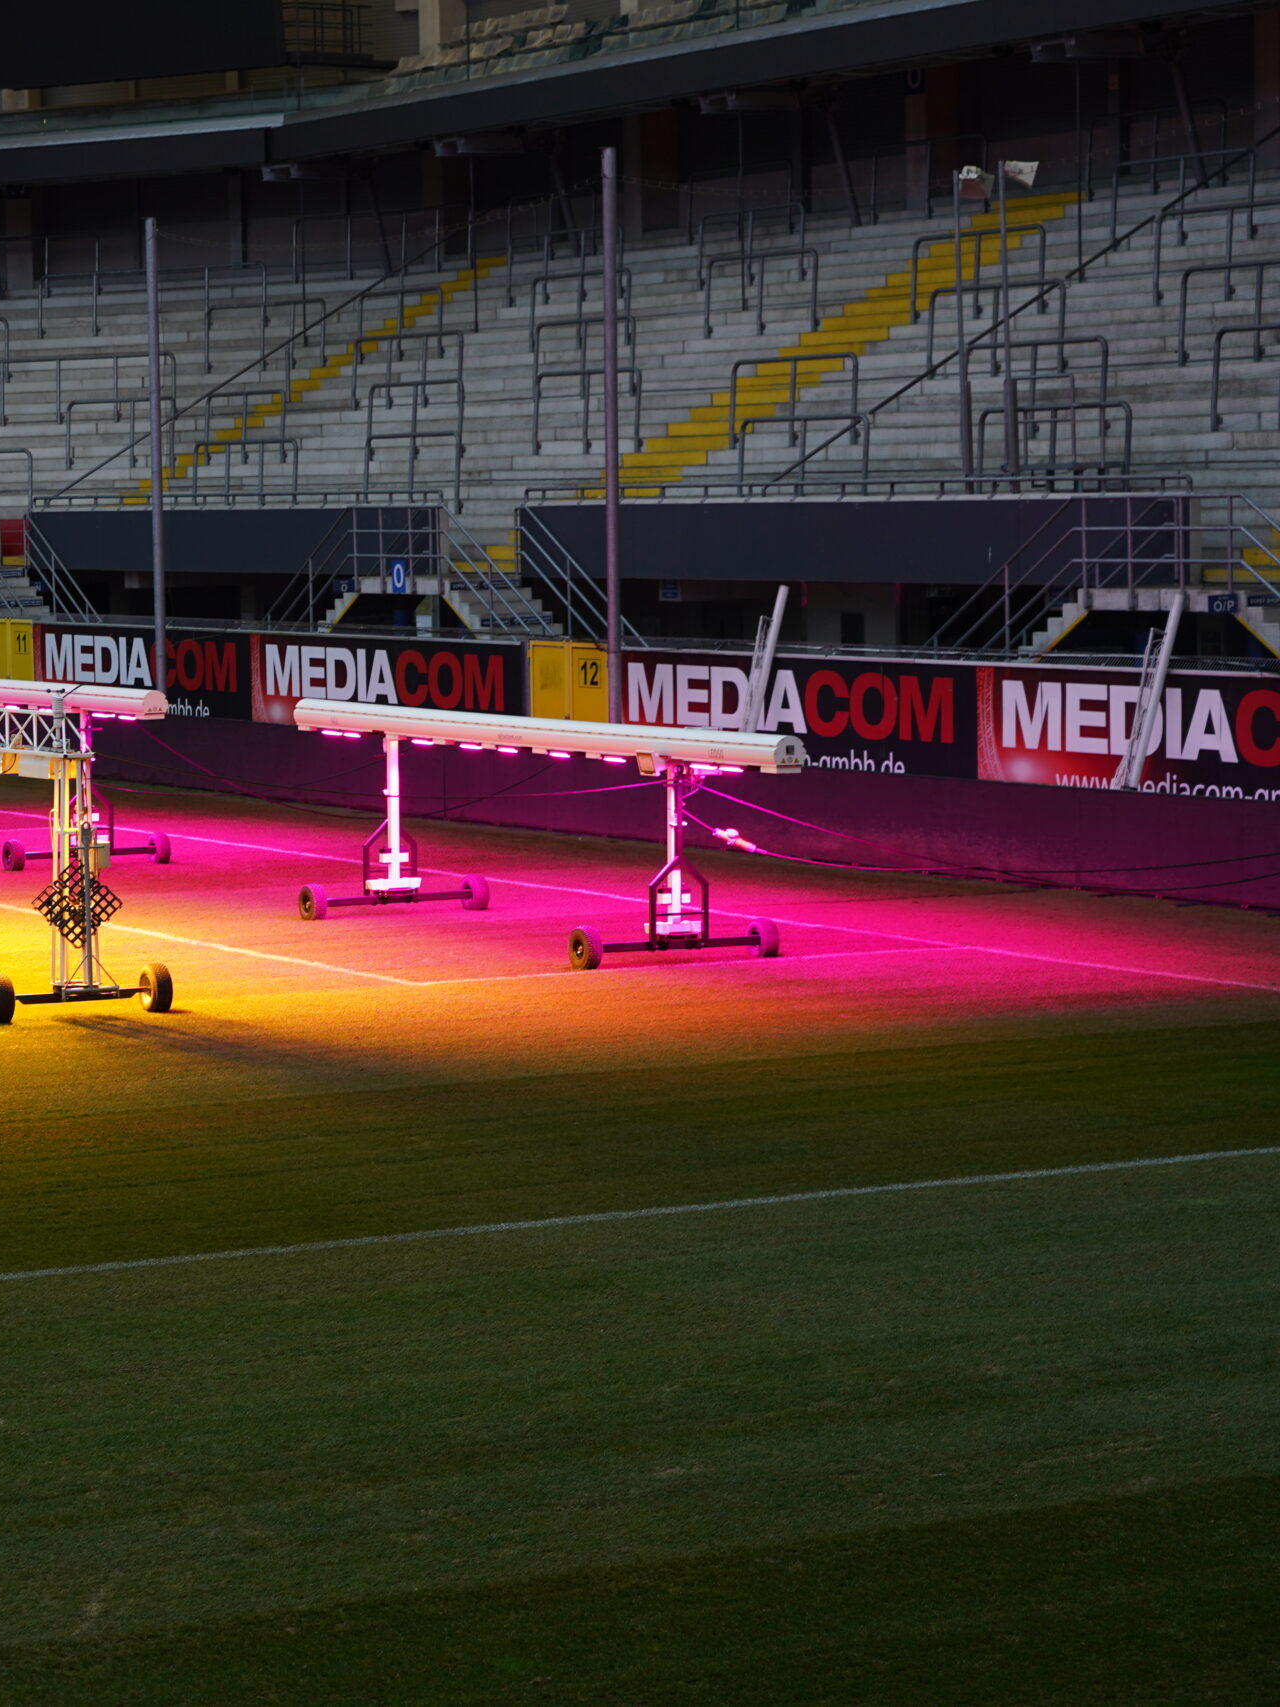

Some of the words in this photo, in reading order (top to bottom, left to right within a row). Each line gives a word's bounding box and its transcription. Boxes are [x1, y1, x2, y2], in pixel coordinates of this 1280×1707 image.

[1213, 599, 1235, 612] O/P
[16, 633, 27, 652] 11
[44, 632, 237, 693] MEDIACOM
[265, 643, 505, 712] MEDIACOM
[580, 660, 600, 686] 12
[627, 661, 955, 744] MEDACOM
